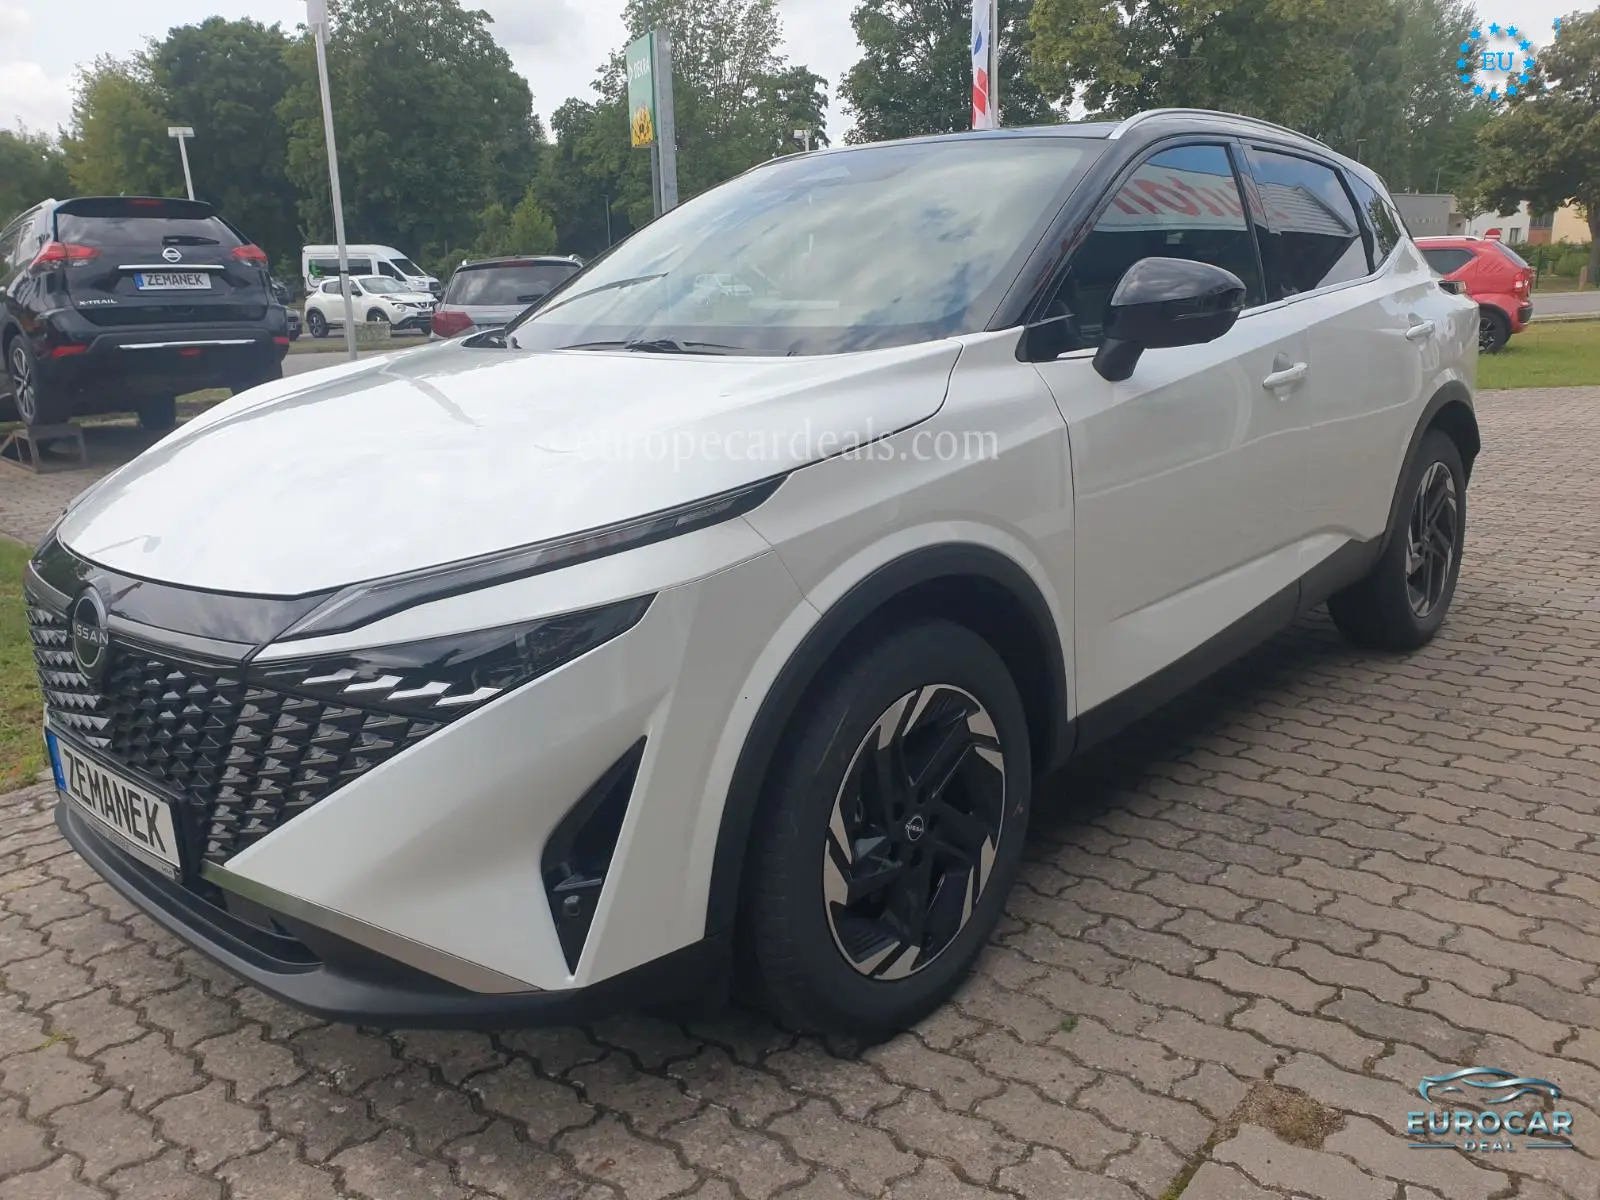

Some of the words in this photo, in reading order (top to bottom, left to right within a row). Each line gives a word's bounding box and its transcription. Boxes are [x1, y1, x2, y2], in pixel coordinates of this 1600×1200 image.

[146, 273, 204, 286] ZEMANEK
[79, 298, 118, 306] X-TRAIL
[71, 623, 109, 646] SSAN
[63, 748, 167, 854] ZEMANEK
